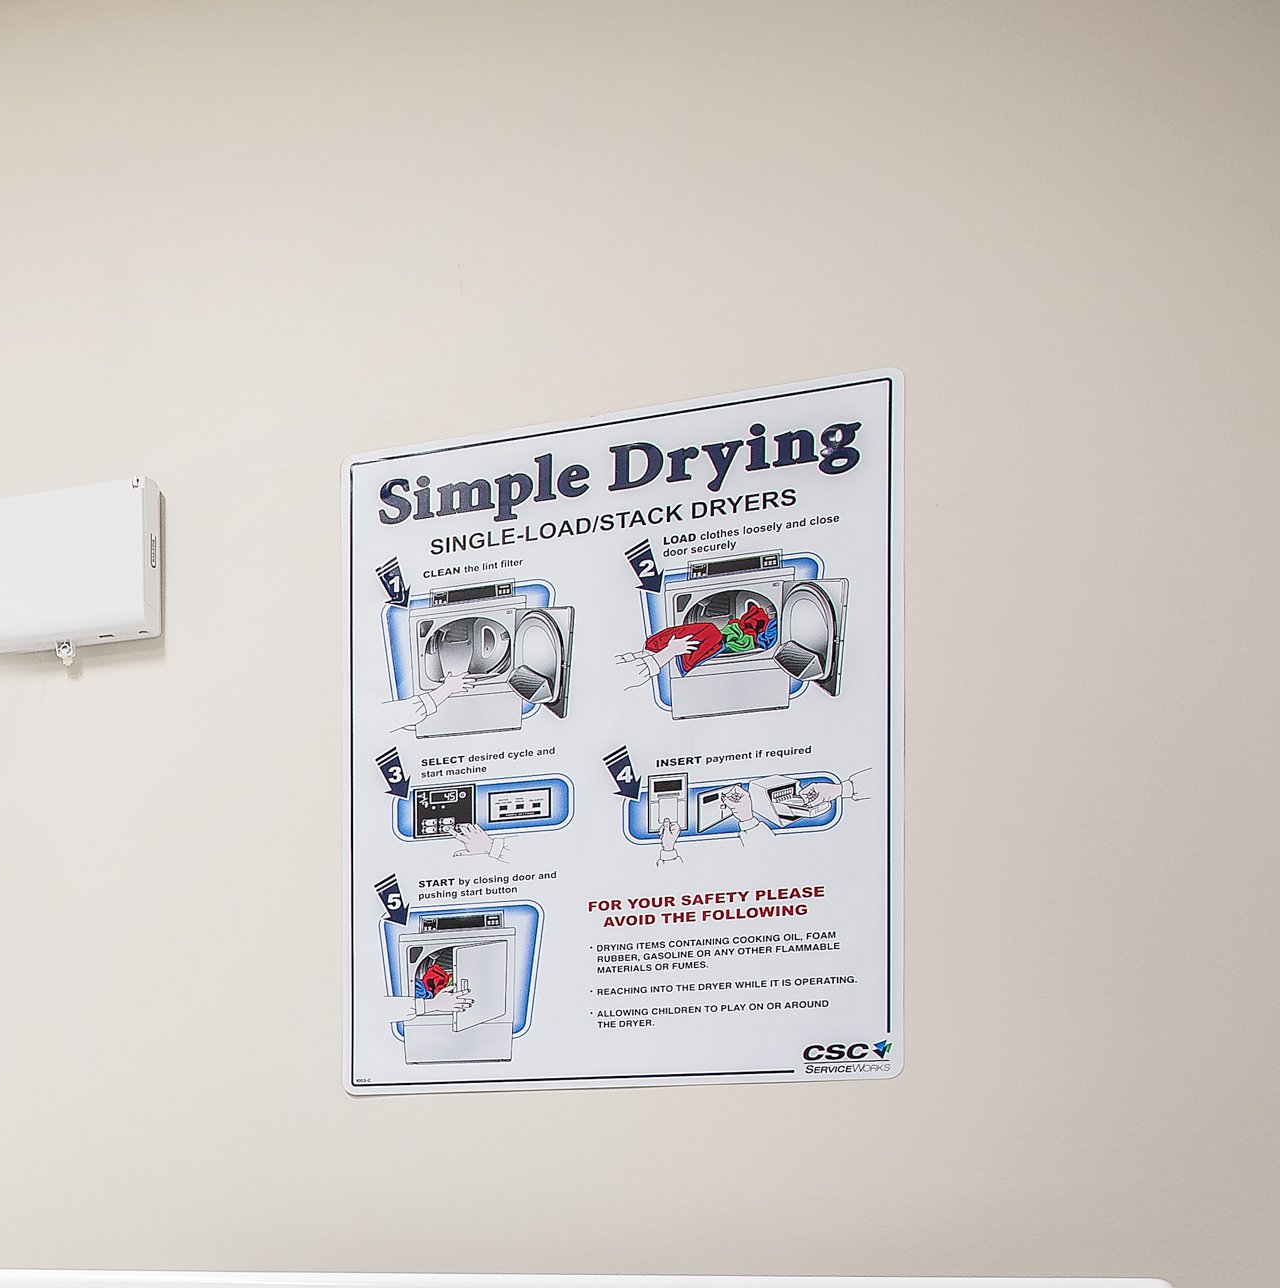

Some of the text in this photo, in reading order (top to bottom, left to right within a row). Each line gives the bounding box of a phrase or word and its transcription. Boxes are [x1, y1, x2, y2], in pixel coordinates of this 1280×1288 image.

[379, 422, 862, 524] Simple Drying
[431, 489, 796, 554] SINGLE-LOAD/STACK DRYERS
[664, 516, 839, 545] LOAD clothes loosely and close
[663, 540, 736, 557] door securely
[423, 567, 460, 578] CLEAN
[483, 562, 497, 570] lint
[501, 560, 523, 568] filter
[639, 559, 655, 576] 2
[389, 575, 402, 599] 1
[422, 747, 555, 766] SELECT desired cycle and
[656, 746, 811, 767] INSERT payment if required
[389, 766, 404, 784] 3
[422, 766, 486, 778] start machine
[618, 766, 634, 784] 4
[388, 892, 403, 910] 5
[589, 886, 824, 912] FOR YOUR SAFETY PLEASE
[604, 905, 807, 927] AVOID THE FOLLOWING
[803, 1044, 869, 1060] CSC
